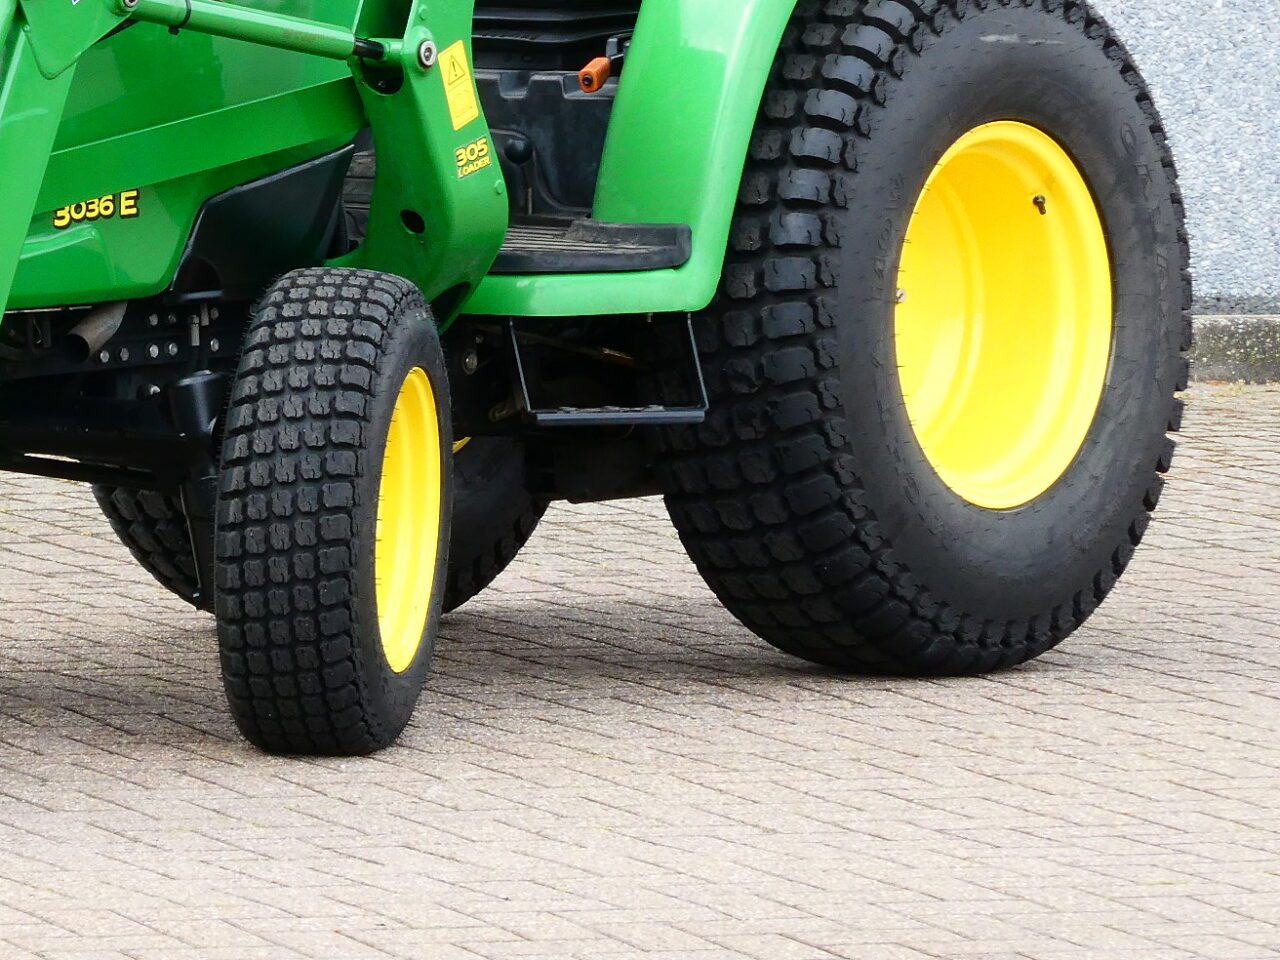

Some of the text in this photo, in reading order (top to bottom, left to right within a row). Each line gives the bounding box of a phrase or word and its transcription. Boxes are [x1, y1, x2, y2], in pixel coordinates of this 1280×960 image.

[455, 137, 488, 167] 305
[457, 156, 491, 178] LOADER
[52, 189, 138, 229] 3036 E
